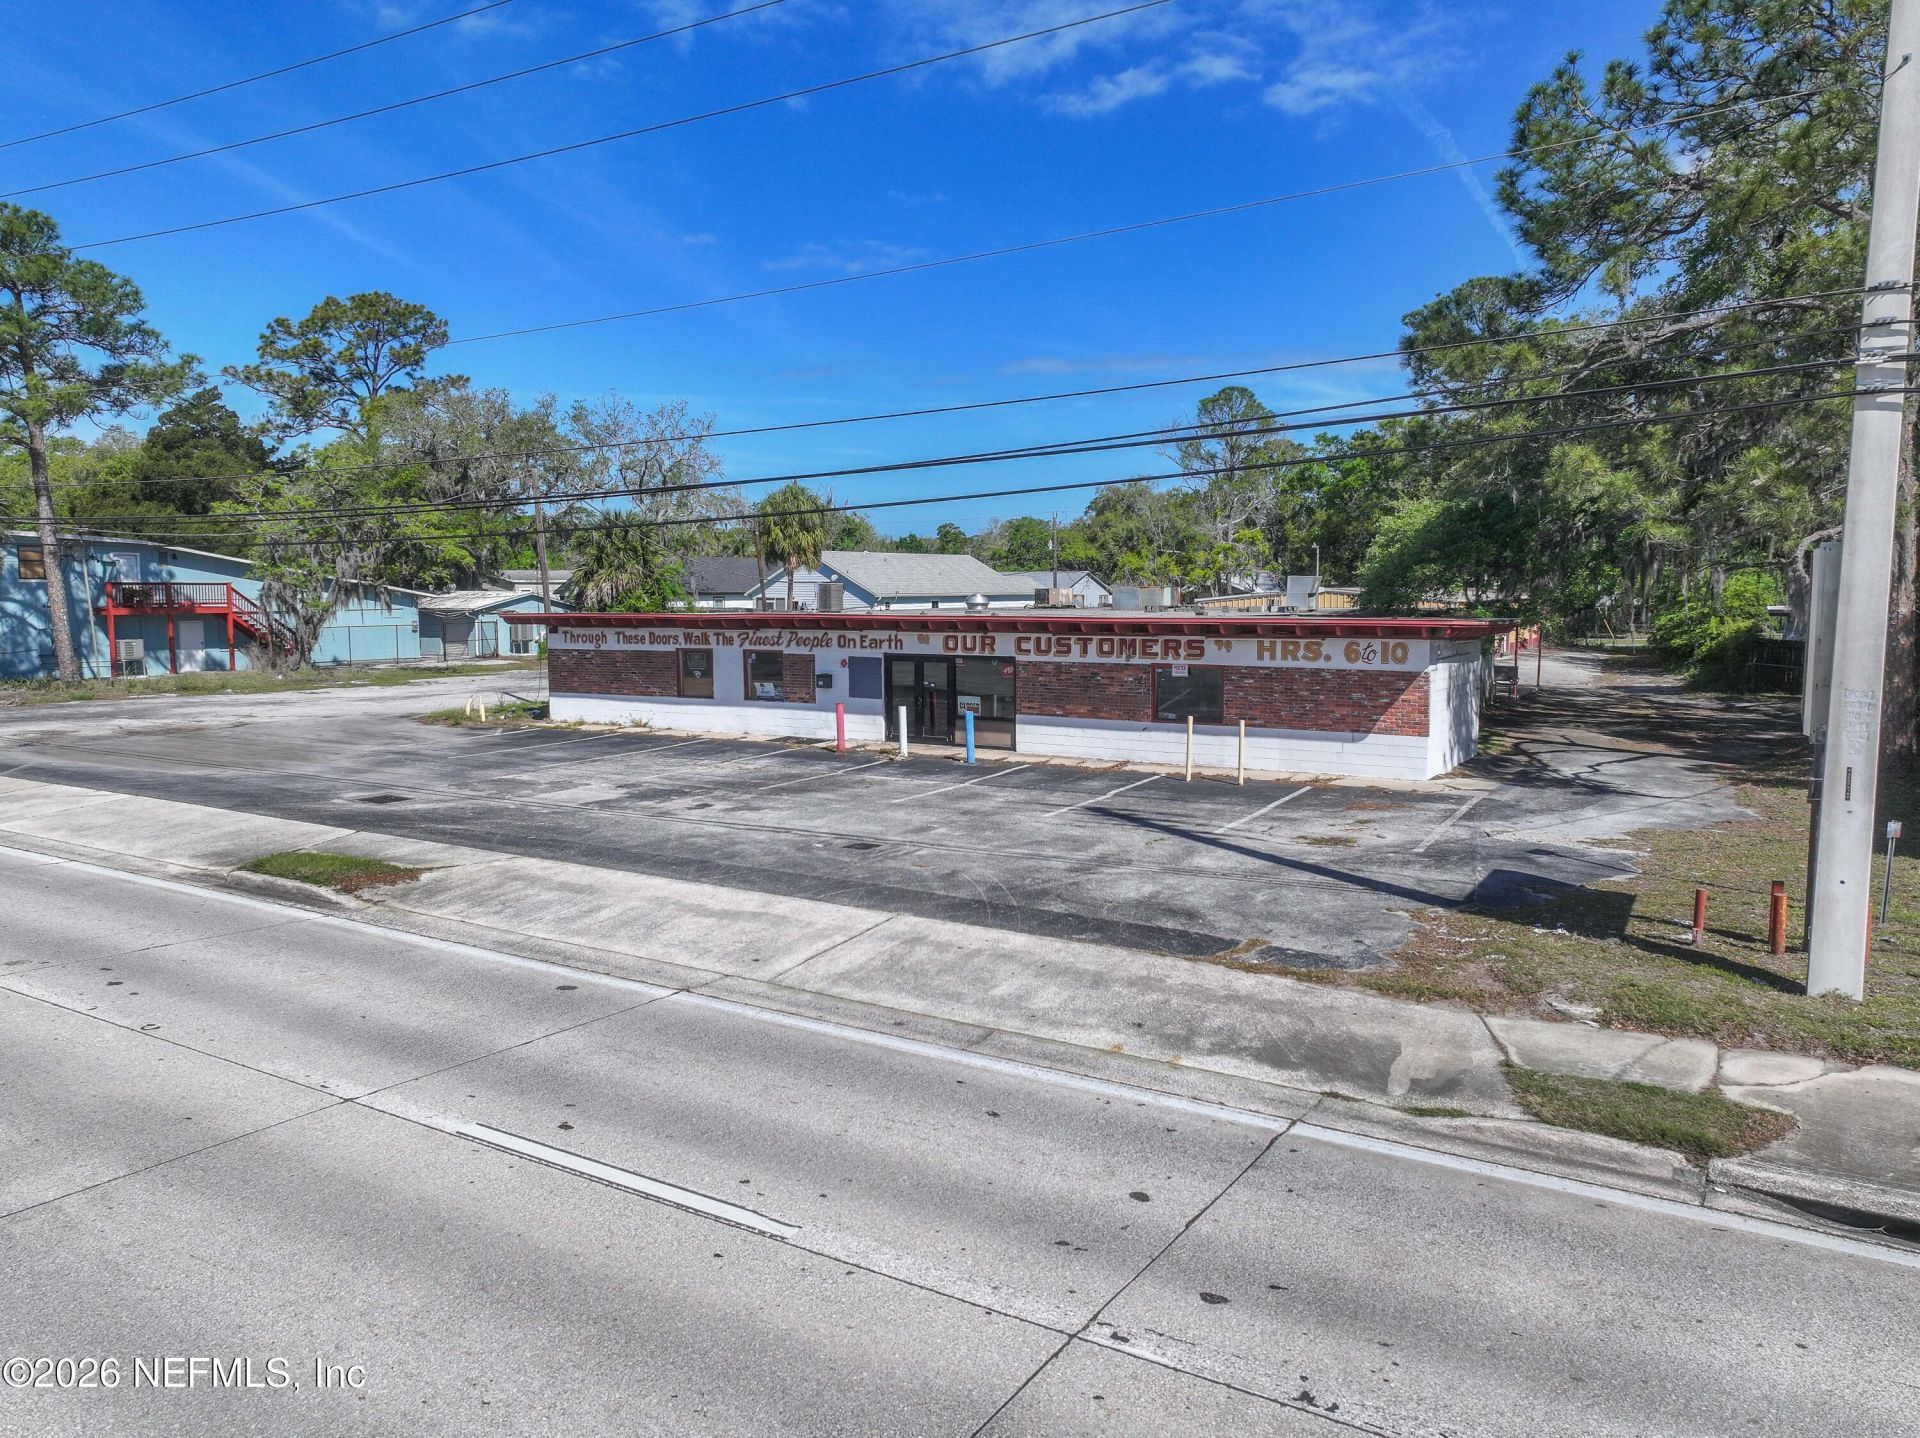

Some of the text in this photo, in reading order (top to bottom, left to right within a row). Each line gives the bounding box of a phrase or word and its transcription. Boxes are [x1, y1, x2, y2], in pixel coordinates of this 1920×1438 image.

[562, 630, 904, 652] Through These Doors, Walk The Finest People On Earth
[1256, 639, 1332, 663] HRS.
[1343, 640, 1362, 665] 6
[1380, 641, 1410, 665] 10
